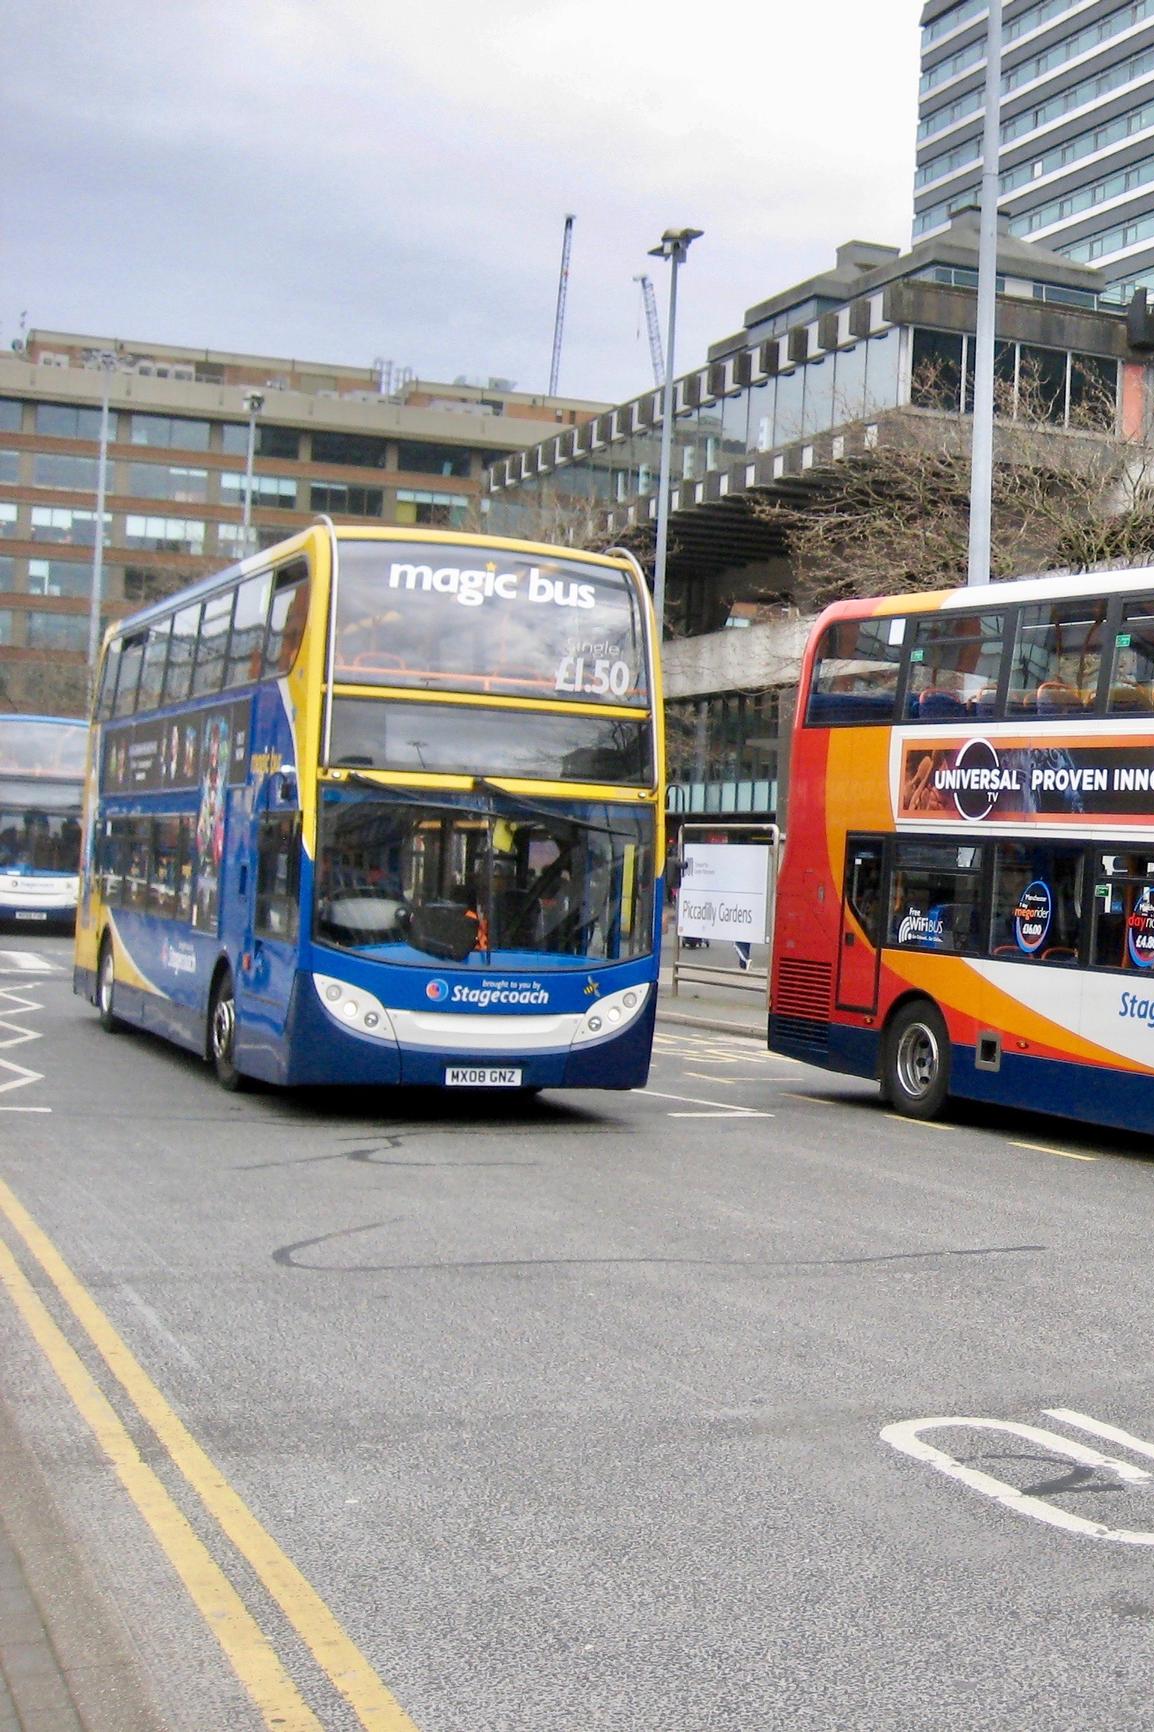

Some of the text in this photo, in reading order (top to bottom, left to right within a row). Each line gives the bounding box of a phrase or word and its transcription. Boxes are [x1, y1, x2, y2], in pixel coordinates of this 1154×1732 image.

[389, 561, 595, 609] magic bus
[555, 656, 630, 696] £1.50
[934, 767, 1021, 791] UNIVERSAL
[1031, 768, 1106, 791] PROVEN
[987, 791, 999, 803] TV
[682, 900, 753, 927] Piccadilly Gardens
[452, 985, 549, 1006] Stagecoach
[450, 1070, 515, 1084] MX08 GNZ
